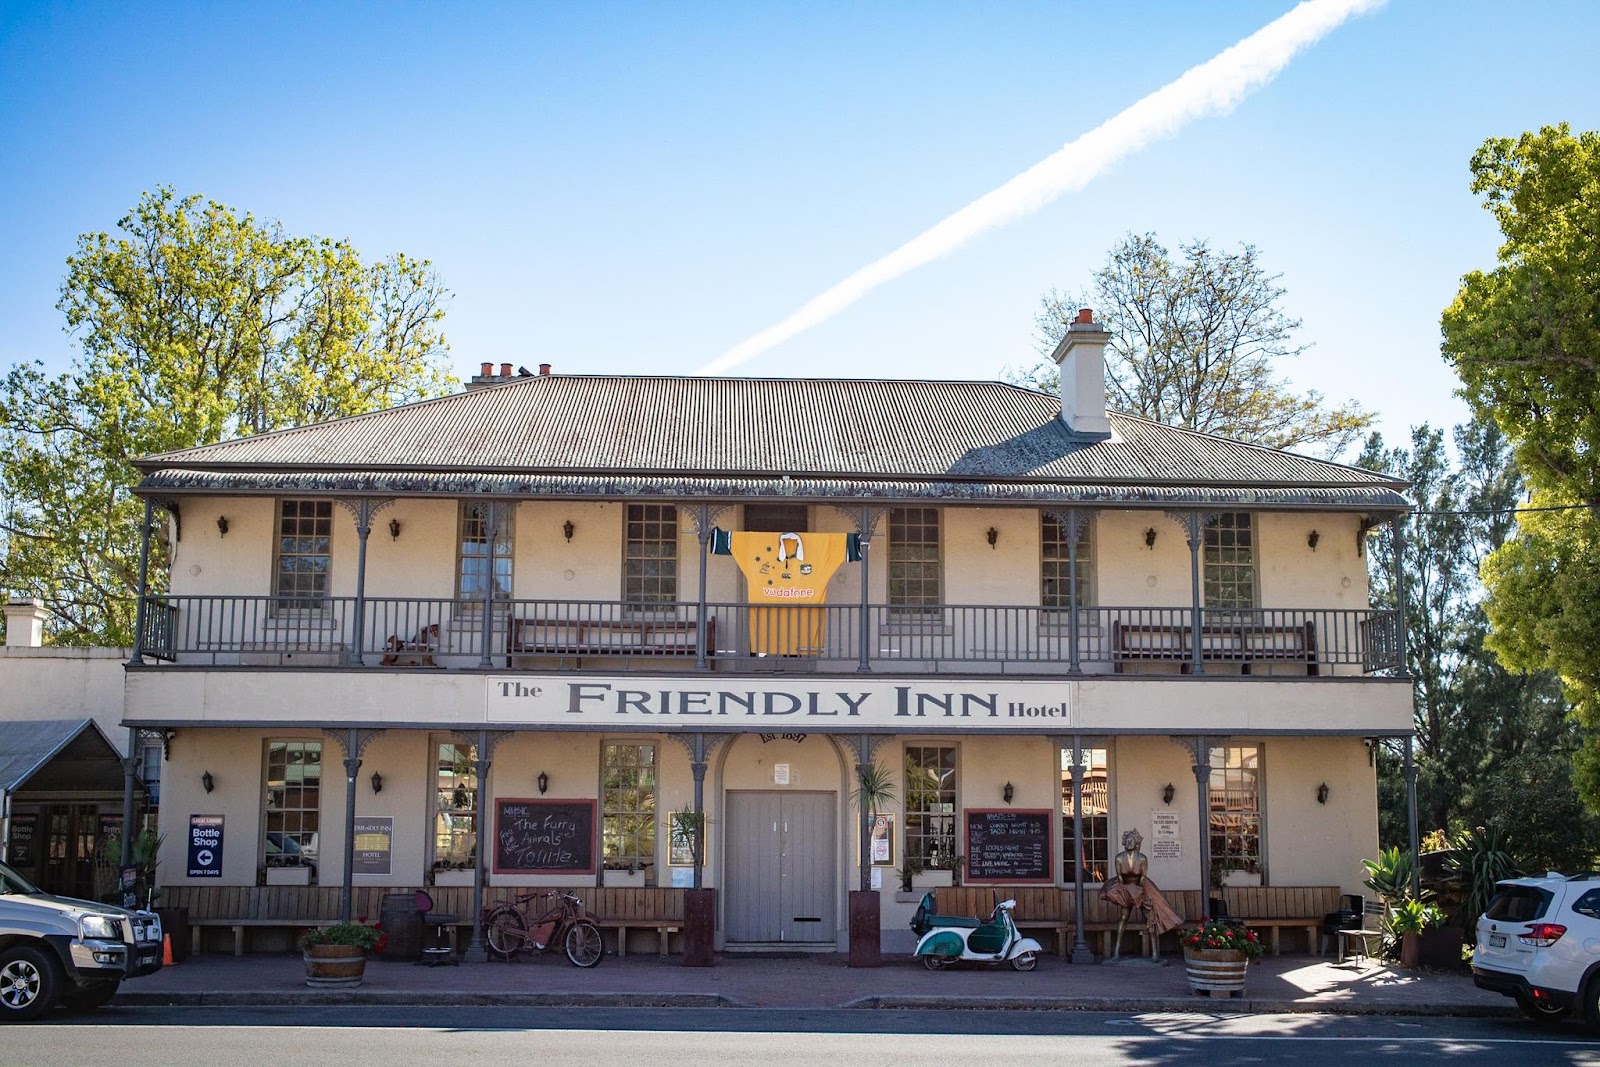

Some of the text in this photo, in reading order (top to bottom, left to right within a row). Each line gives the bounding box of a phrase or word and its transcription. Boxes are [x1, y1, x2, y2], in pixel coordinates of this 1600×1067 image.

[763, 587, 814, 597] vodafone
[498, 682, 1067, 717] The FRIENDLY INN Hotel
[11, 825, 33, 833] Bottle
[514, 815, 576, 838] The Furry
[12, 832, 31, 842] Shop
[192, 828, 220, 837] Bottle
[193, 837, 218, 848] Shop
[521, 831, 561, 846] Animals
